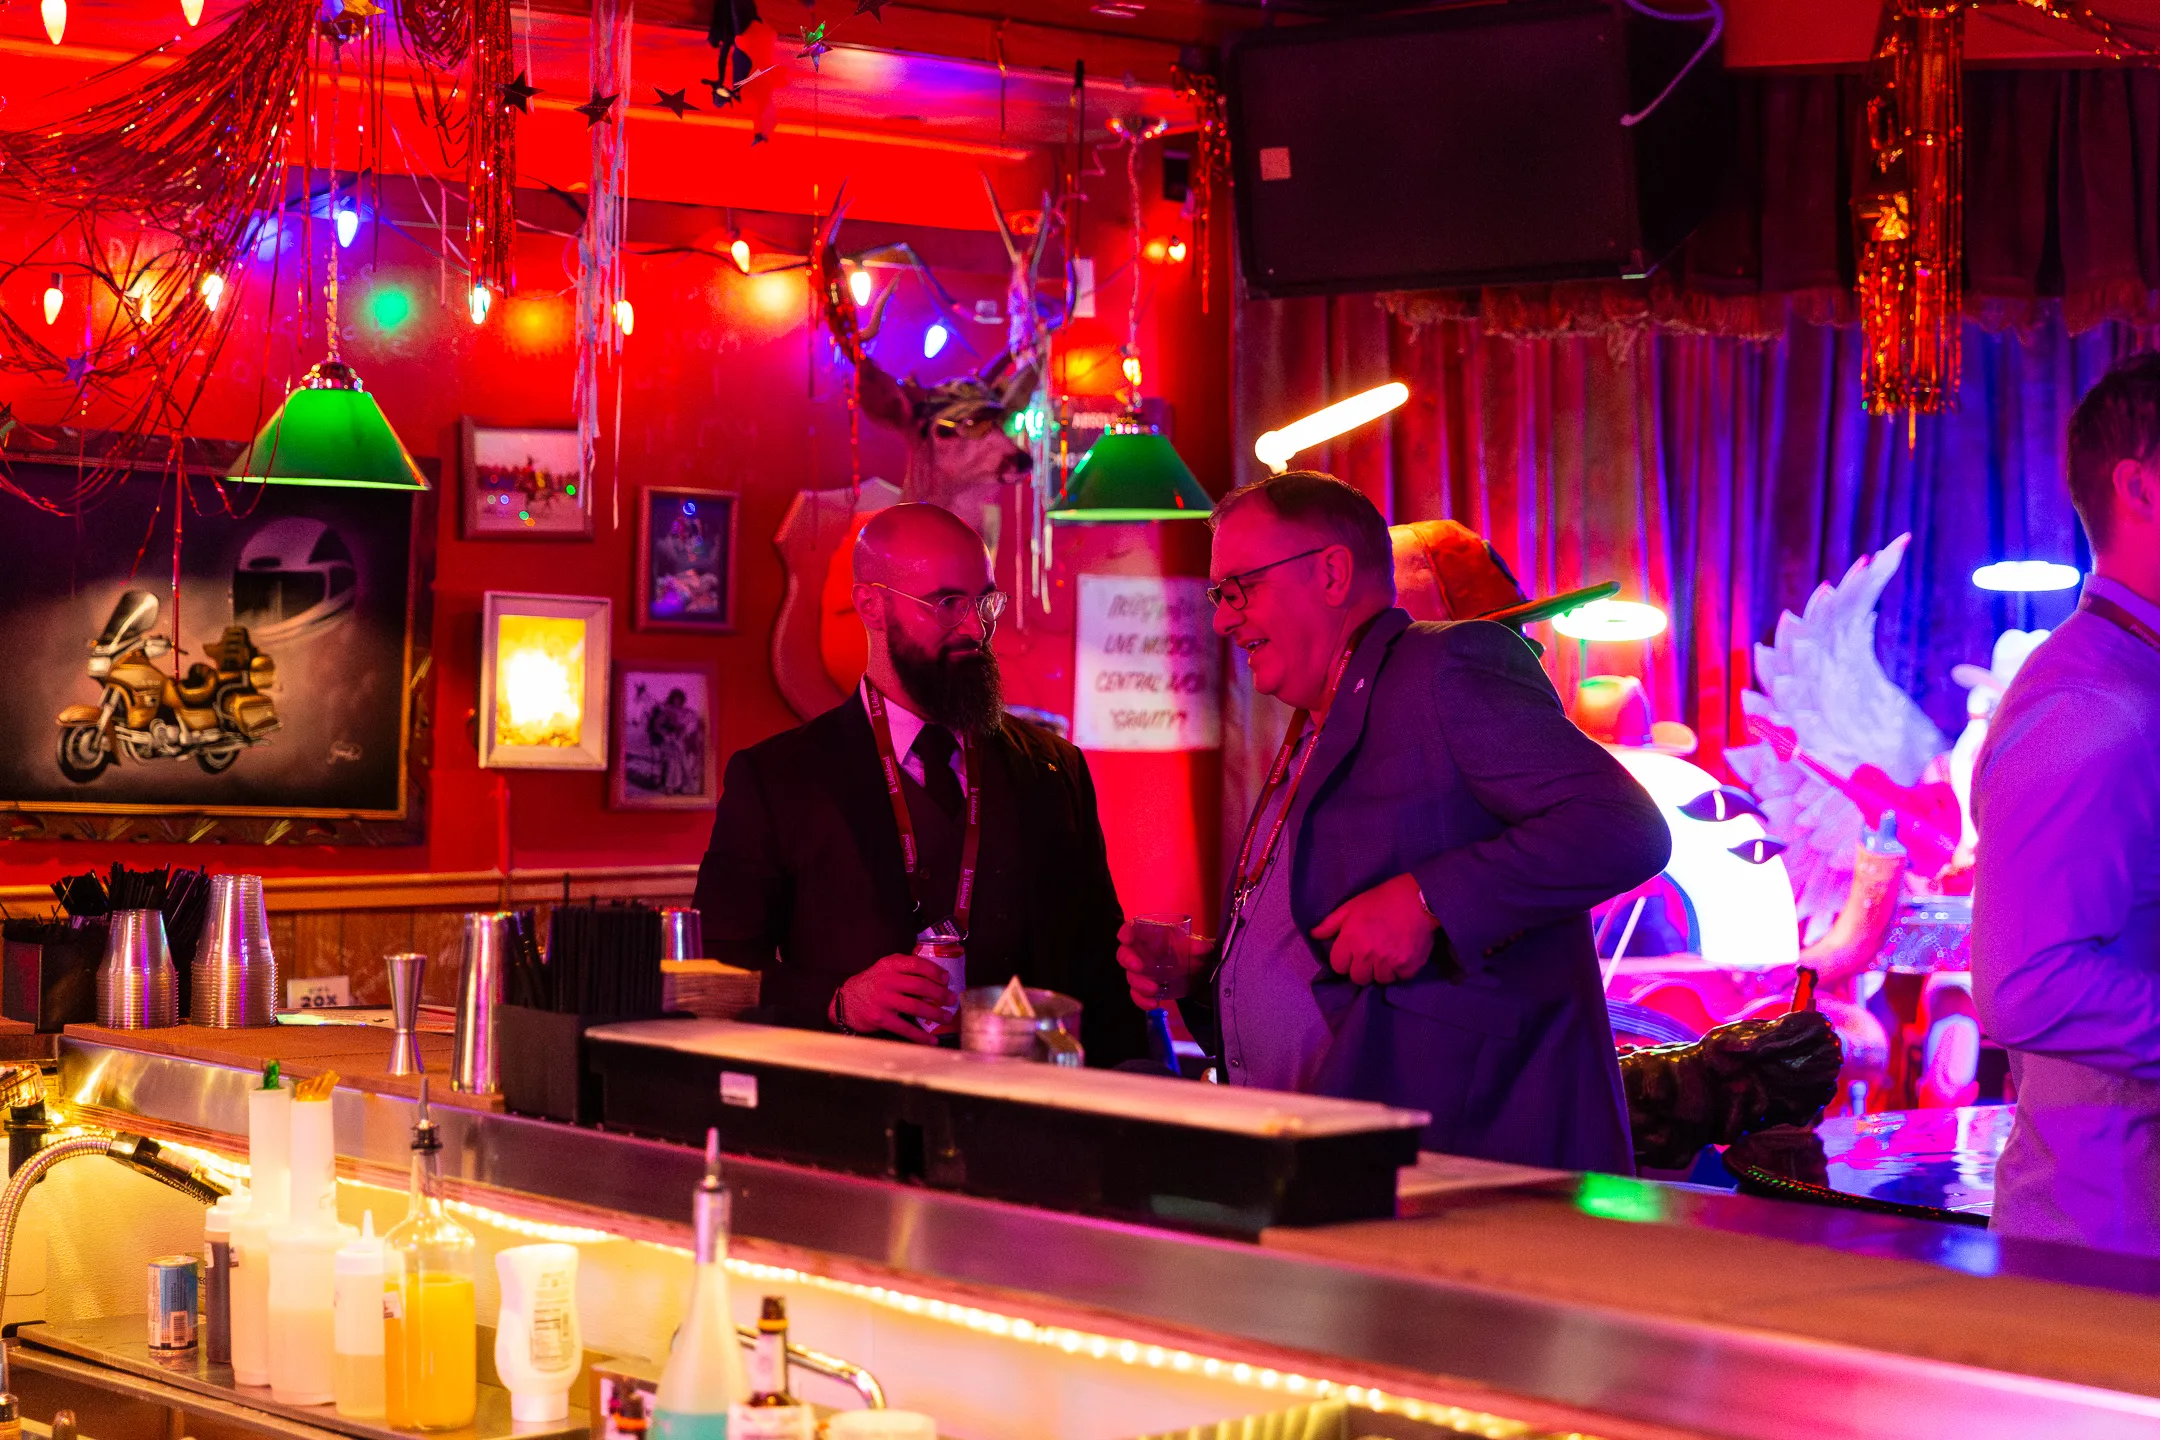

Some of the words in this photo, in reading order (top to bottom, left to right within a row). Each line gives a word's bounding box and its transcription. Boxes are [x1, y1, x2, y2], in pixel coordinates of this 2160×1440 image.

[1095, 670, 1161, 693] CENTRAL
[883, 756, 895, 785] Lifeblood
[903, 834, 914, 864] Lifeblood
[959, 878, 970, 908] Lifeblood
